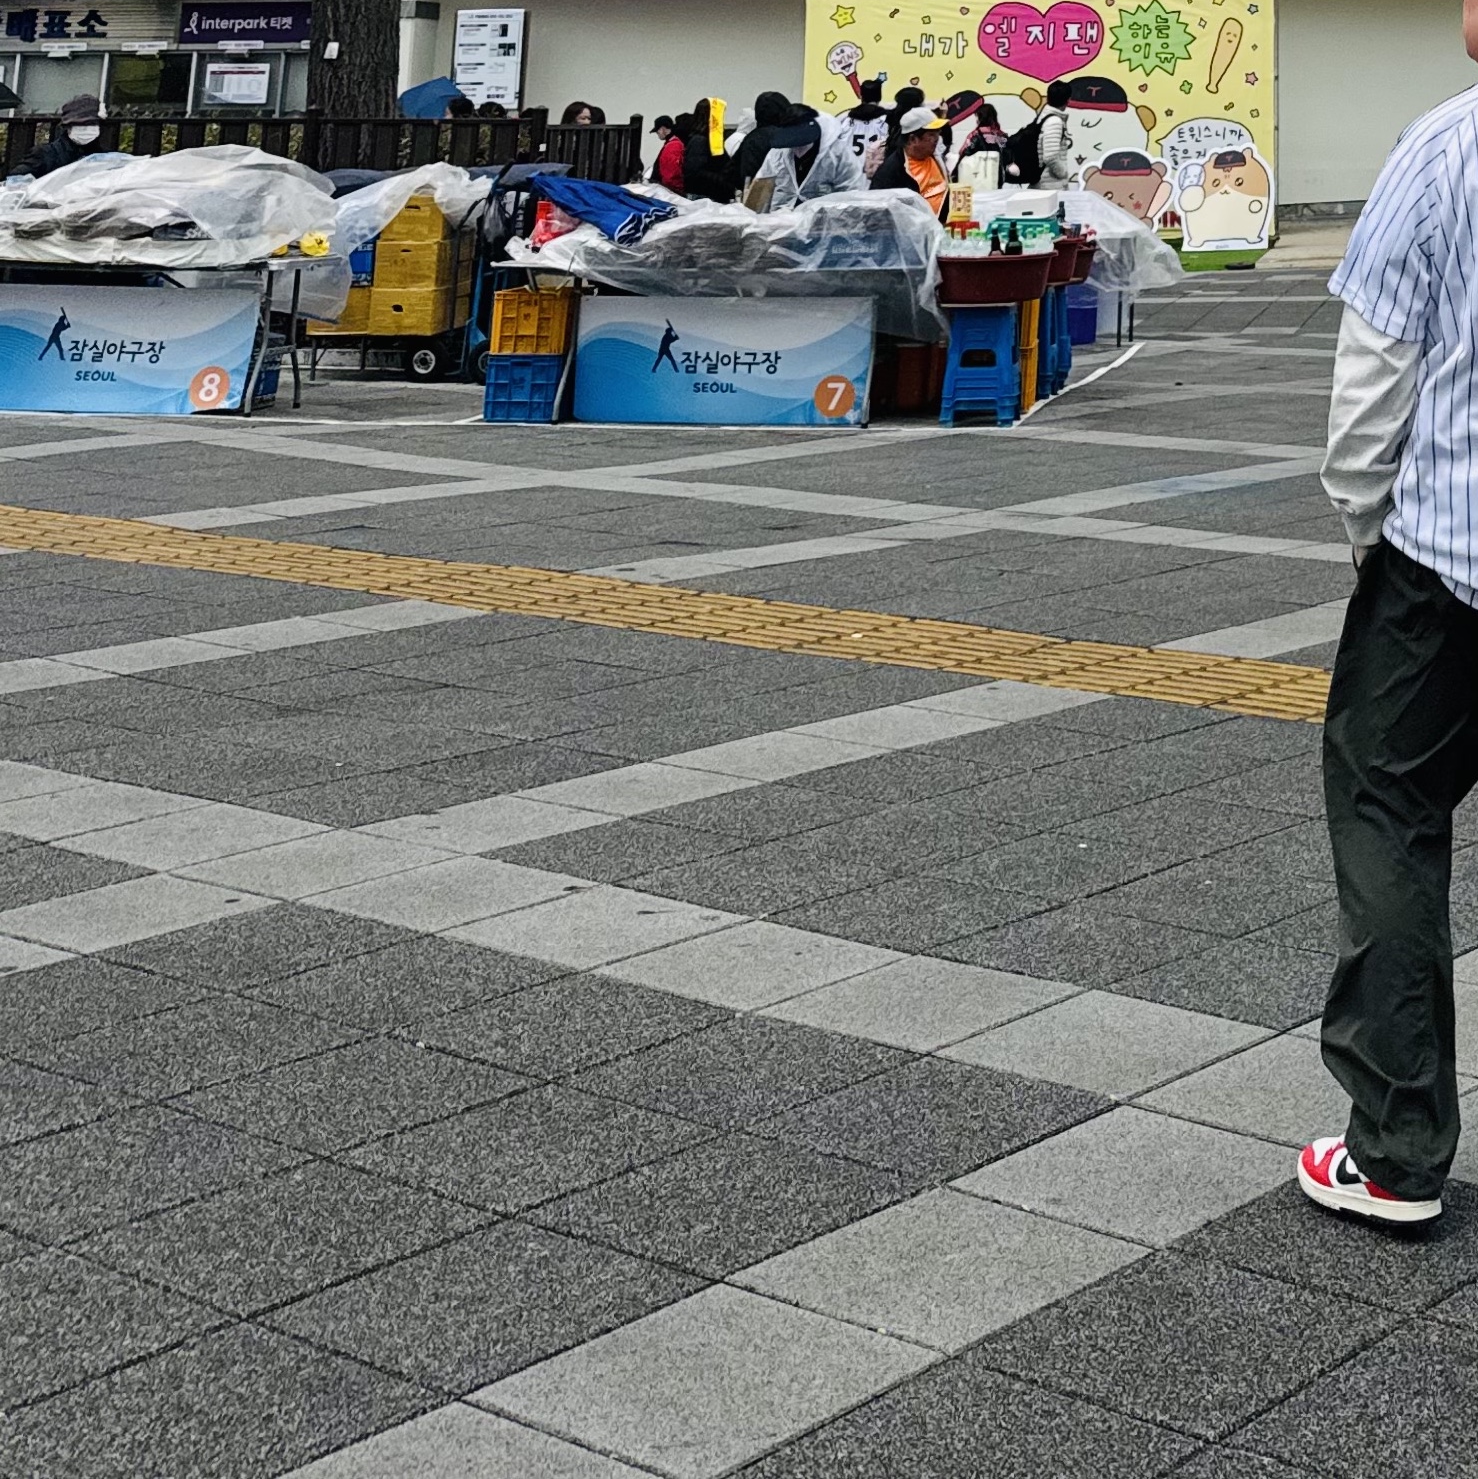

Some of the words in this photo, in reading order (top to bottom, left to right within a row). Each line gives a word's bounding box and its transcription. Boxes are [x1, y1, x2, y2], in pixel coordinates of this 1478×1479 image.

[201, 16, 268, 33] interpark
[270, 16, 293, 30] 티켓
[1128, 15, 1170, 39] 하는
[903, 31, 968, 58] 내가
[983, 16, 1099, 58] 엘지팬
[830, 51, 860, 70] TWINS
[1132, 42, 1175, 63] 이유
[1177, 125, 1245, 144] 트윈스니까
[68, 339, 165, 364] 잠실야구장
[681, 351, 782, 375] 잠실야구장
[75, 369, 117, 382] SEOUL
[198, 372, 221, 403] 8
[692, 381, 738, 394] SEOUL
[826, 382, 846, 411] 7
